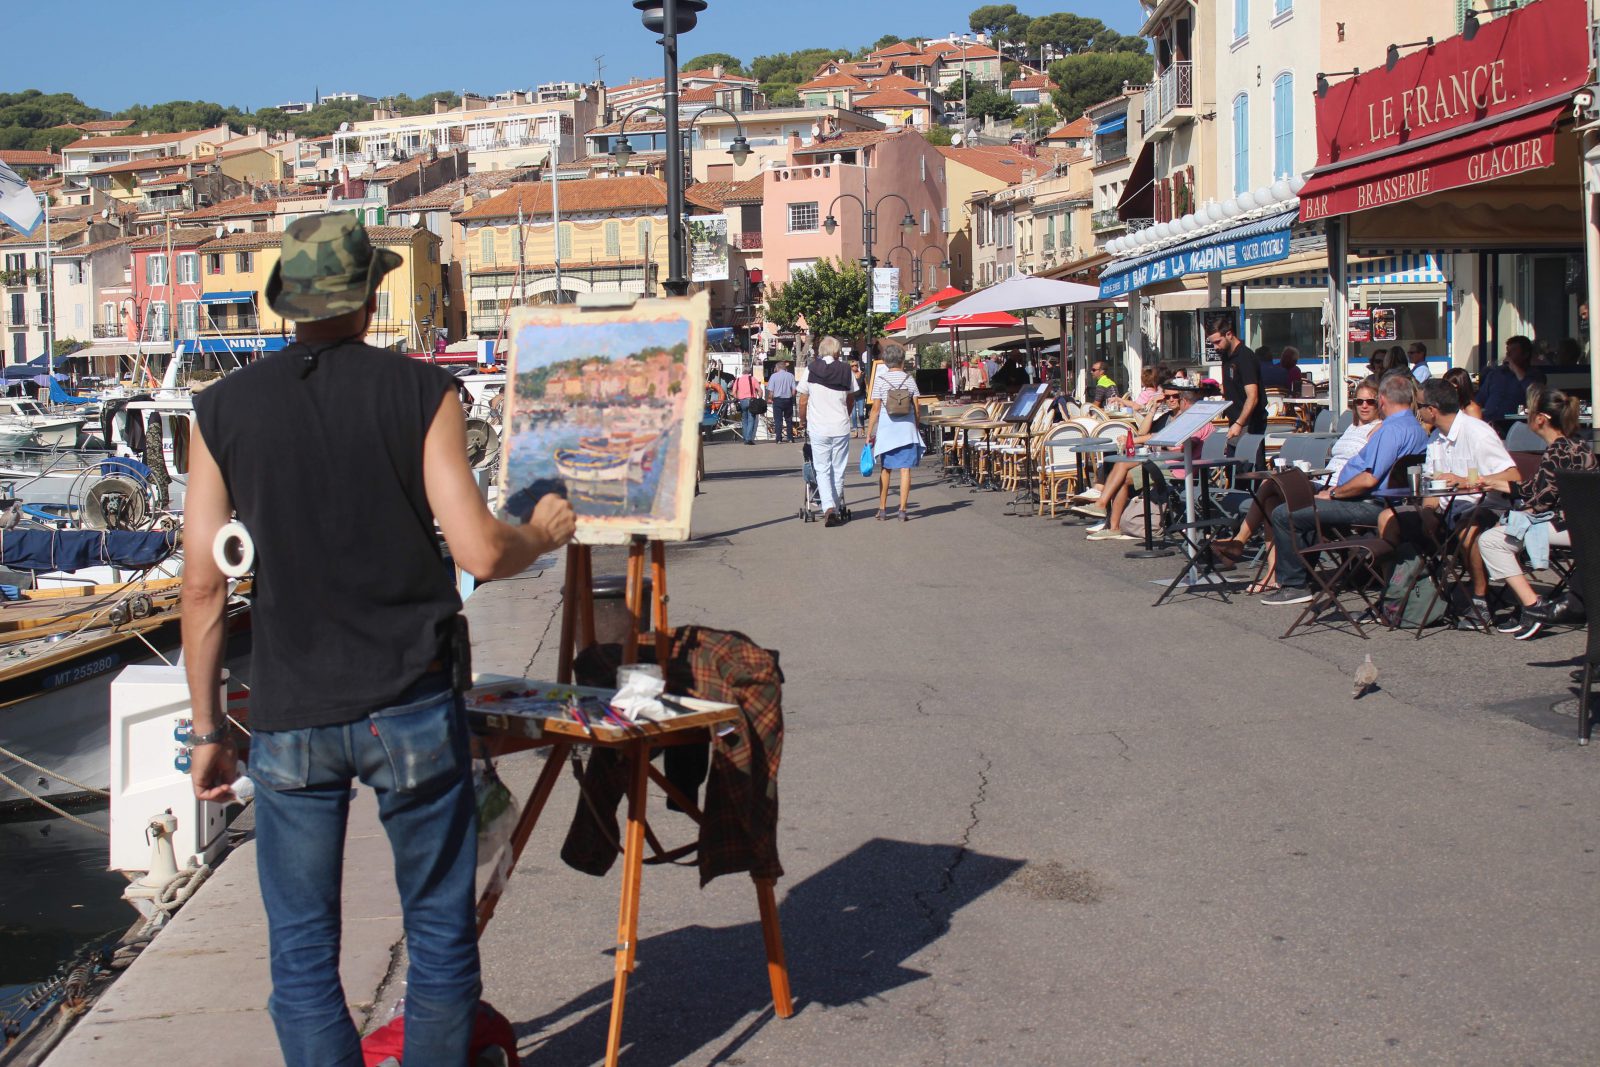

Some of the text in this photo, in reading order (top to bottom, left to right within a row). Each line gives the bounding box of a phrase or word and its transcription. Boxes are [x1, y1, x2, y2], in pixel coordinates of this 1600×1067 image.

[1368, 58, 1507, 142] LE FRANCE
[1305, 137, 1544, 219] BAR BRASSERIE GLACIER
[1132, 266, 1147, 288] BAR
[1152, 261, 1166, 280] DE
[1171, 256, 1185, 275] LA
[1189, 244, 1237, 272] MARINE
[229, 338, 266, 348] NINO
[55, 656, 112, 687] MT 255280
